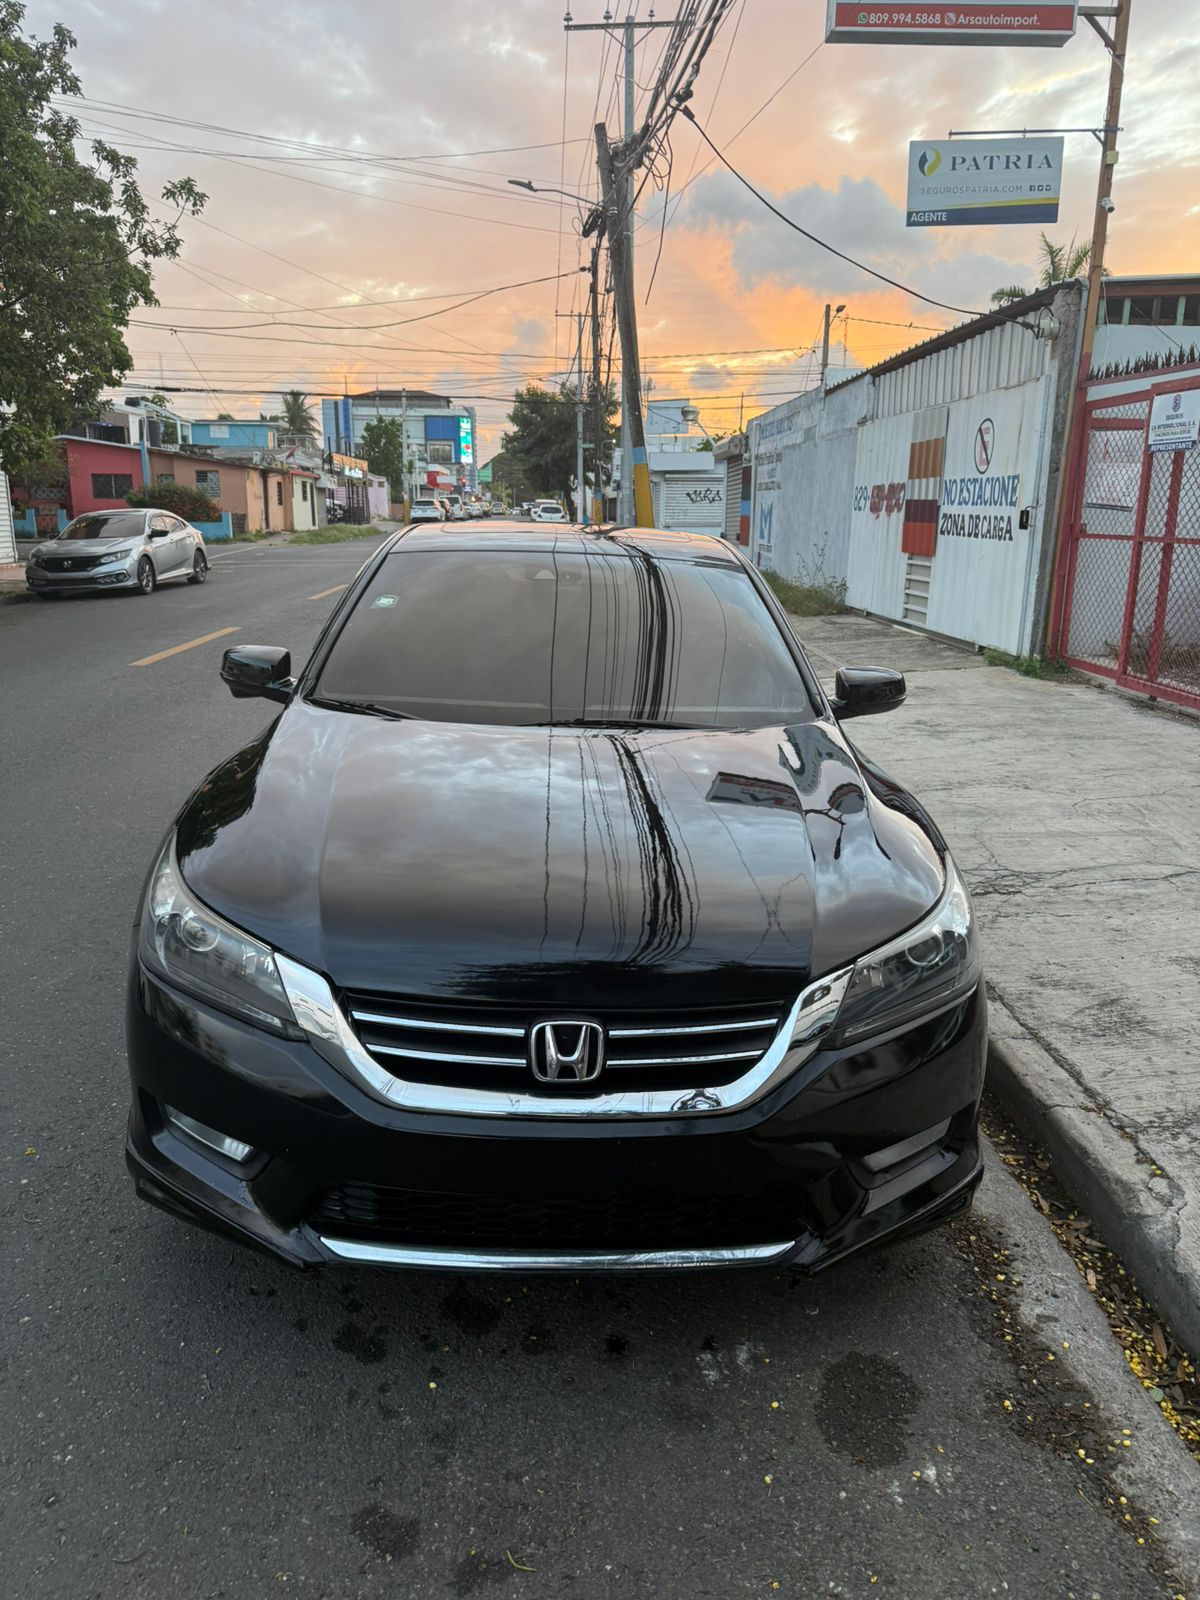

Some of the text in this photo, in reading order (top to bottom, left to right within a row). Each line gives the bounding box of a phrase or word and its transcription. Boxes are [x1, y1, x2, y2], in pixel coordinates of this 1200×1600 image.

[869, 13, 941, 24] 809.994.5868
[951, 153, 1053, 171] PATRIA
[920, 184, 1023, 196] SEGUROSPATRIA.COM
[910, 211, 948, 222] AGENTE
[1151, 442, 1192, 450] REPRESENTANTE
[942, 478, 957, 506] NO
[957, 474, 1020, 508] ESTACIONE
[940, 512, 1014, 541] ZONA DE CARGA
